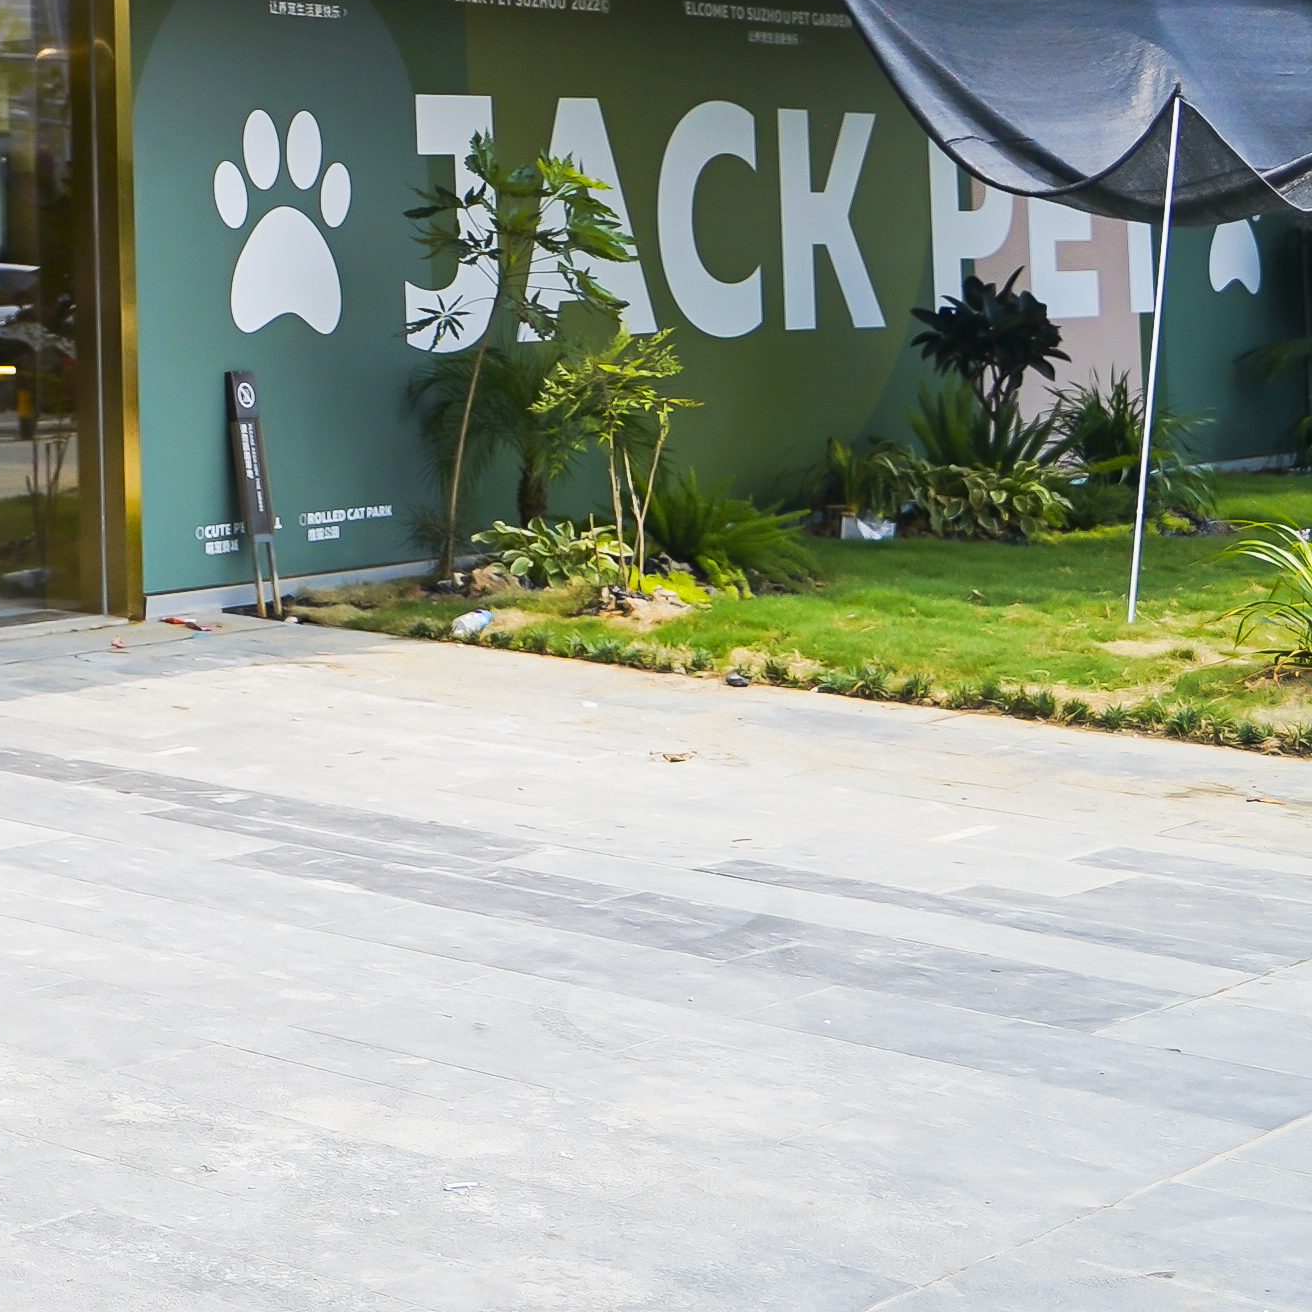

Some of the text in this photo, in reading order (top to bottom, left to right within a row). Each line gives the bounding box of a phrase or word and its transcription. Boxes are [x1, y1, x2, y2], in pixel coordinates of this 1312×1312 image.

[405, 93, 887, 354] JACK
[307, 504, 393, 525] ROLLED CAT PARK
[204, 523, 232, 539] CUTE
